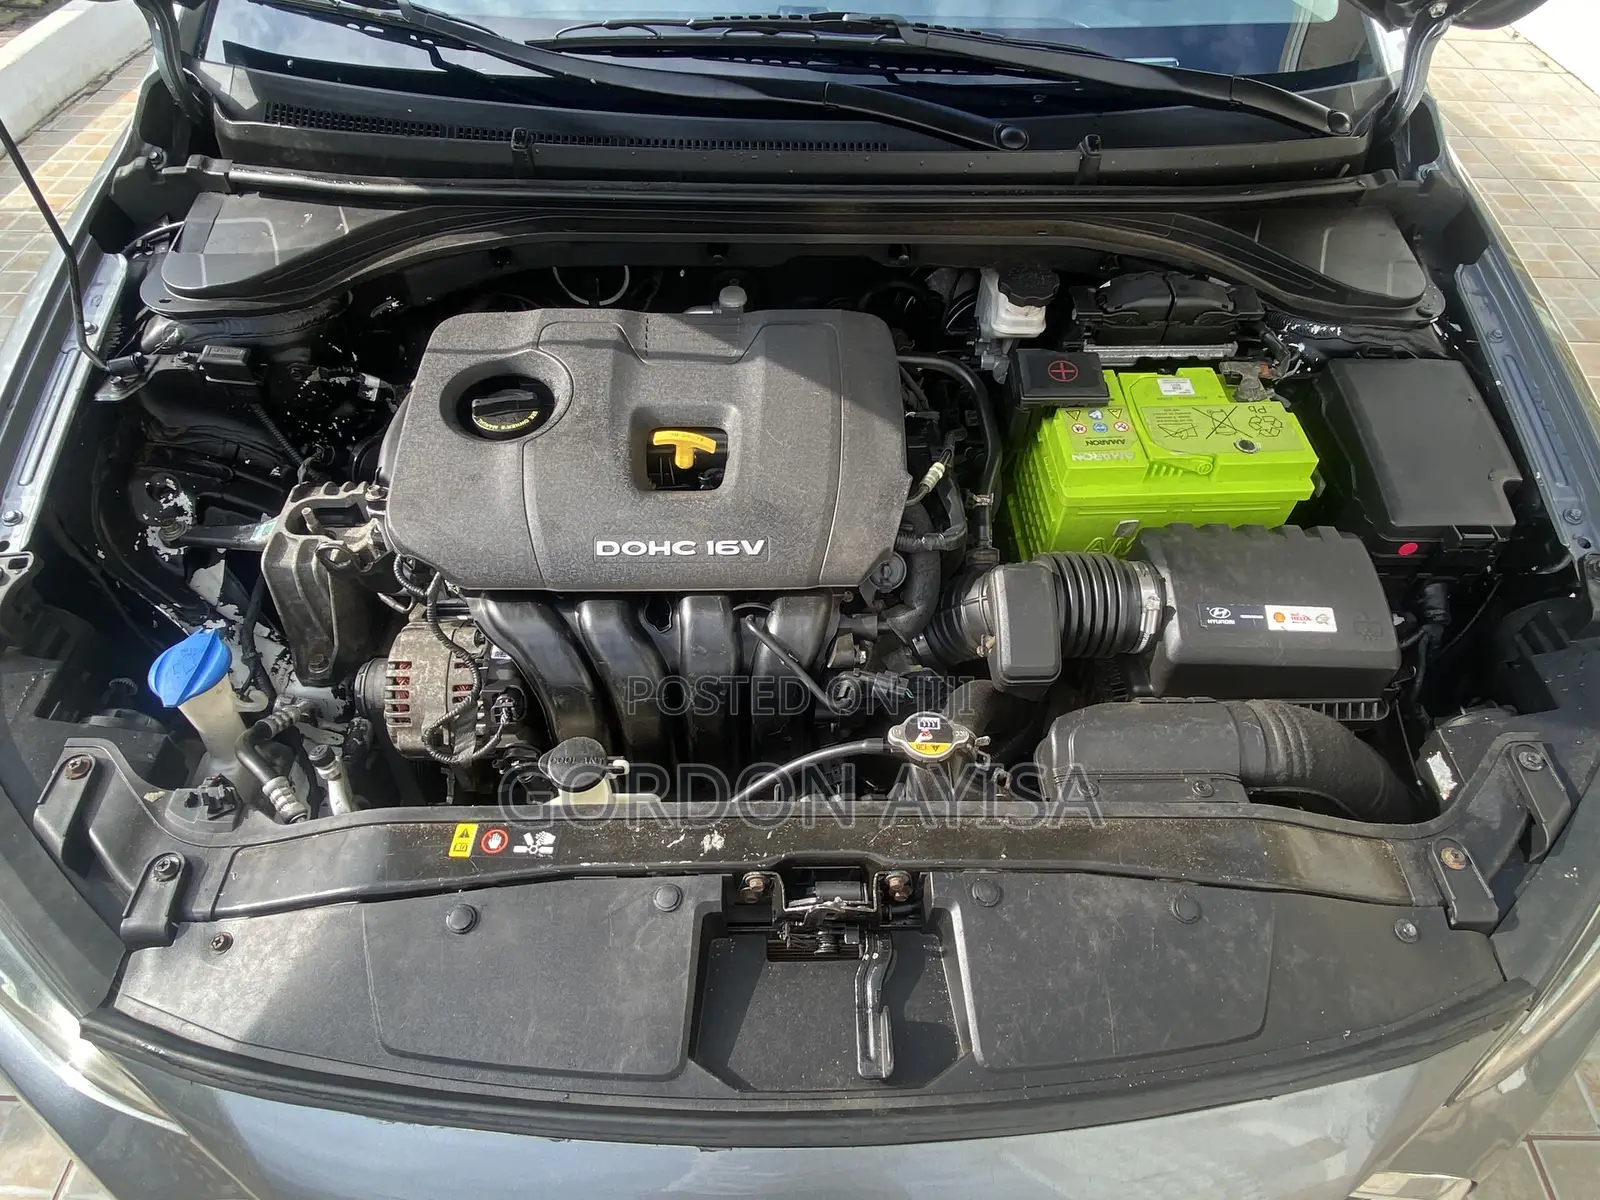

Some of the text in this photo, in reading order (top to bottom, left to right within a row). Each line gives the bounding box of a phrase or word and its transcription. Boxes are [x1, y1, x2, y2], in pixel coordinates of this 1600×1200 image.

[1085, 438, 1126, 447] AMARON
[1071, 451, 1134, 462] AMARON
[596, 539, 766, 557] DOHC 16V
[551, 756, 606, 766] COOLANT
